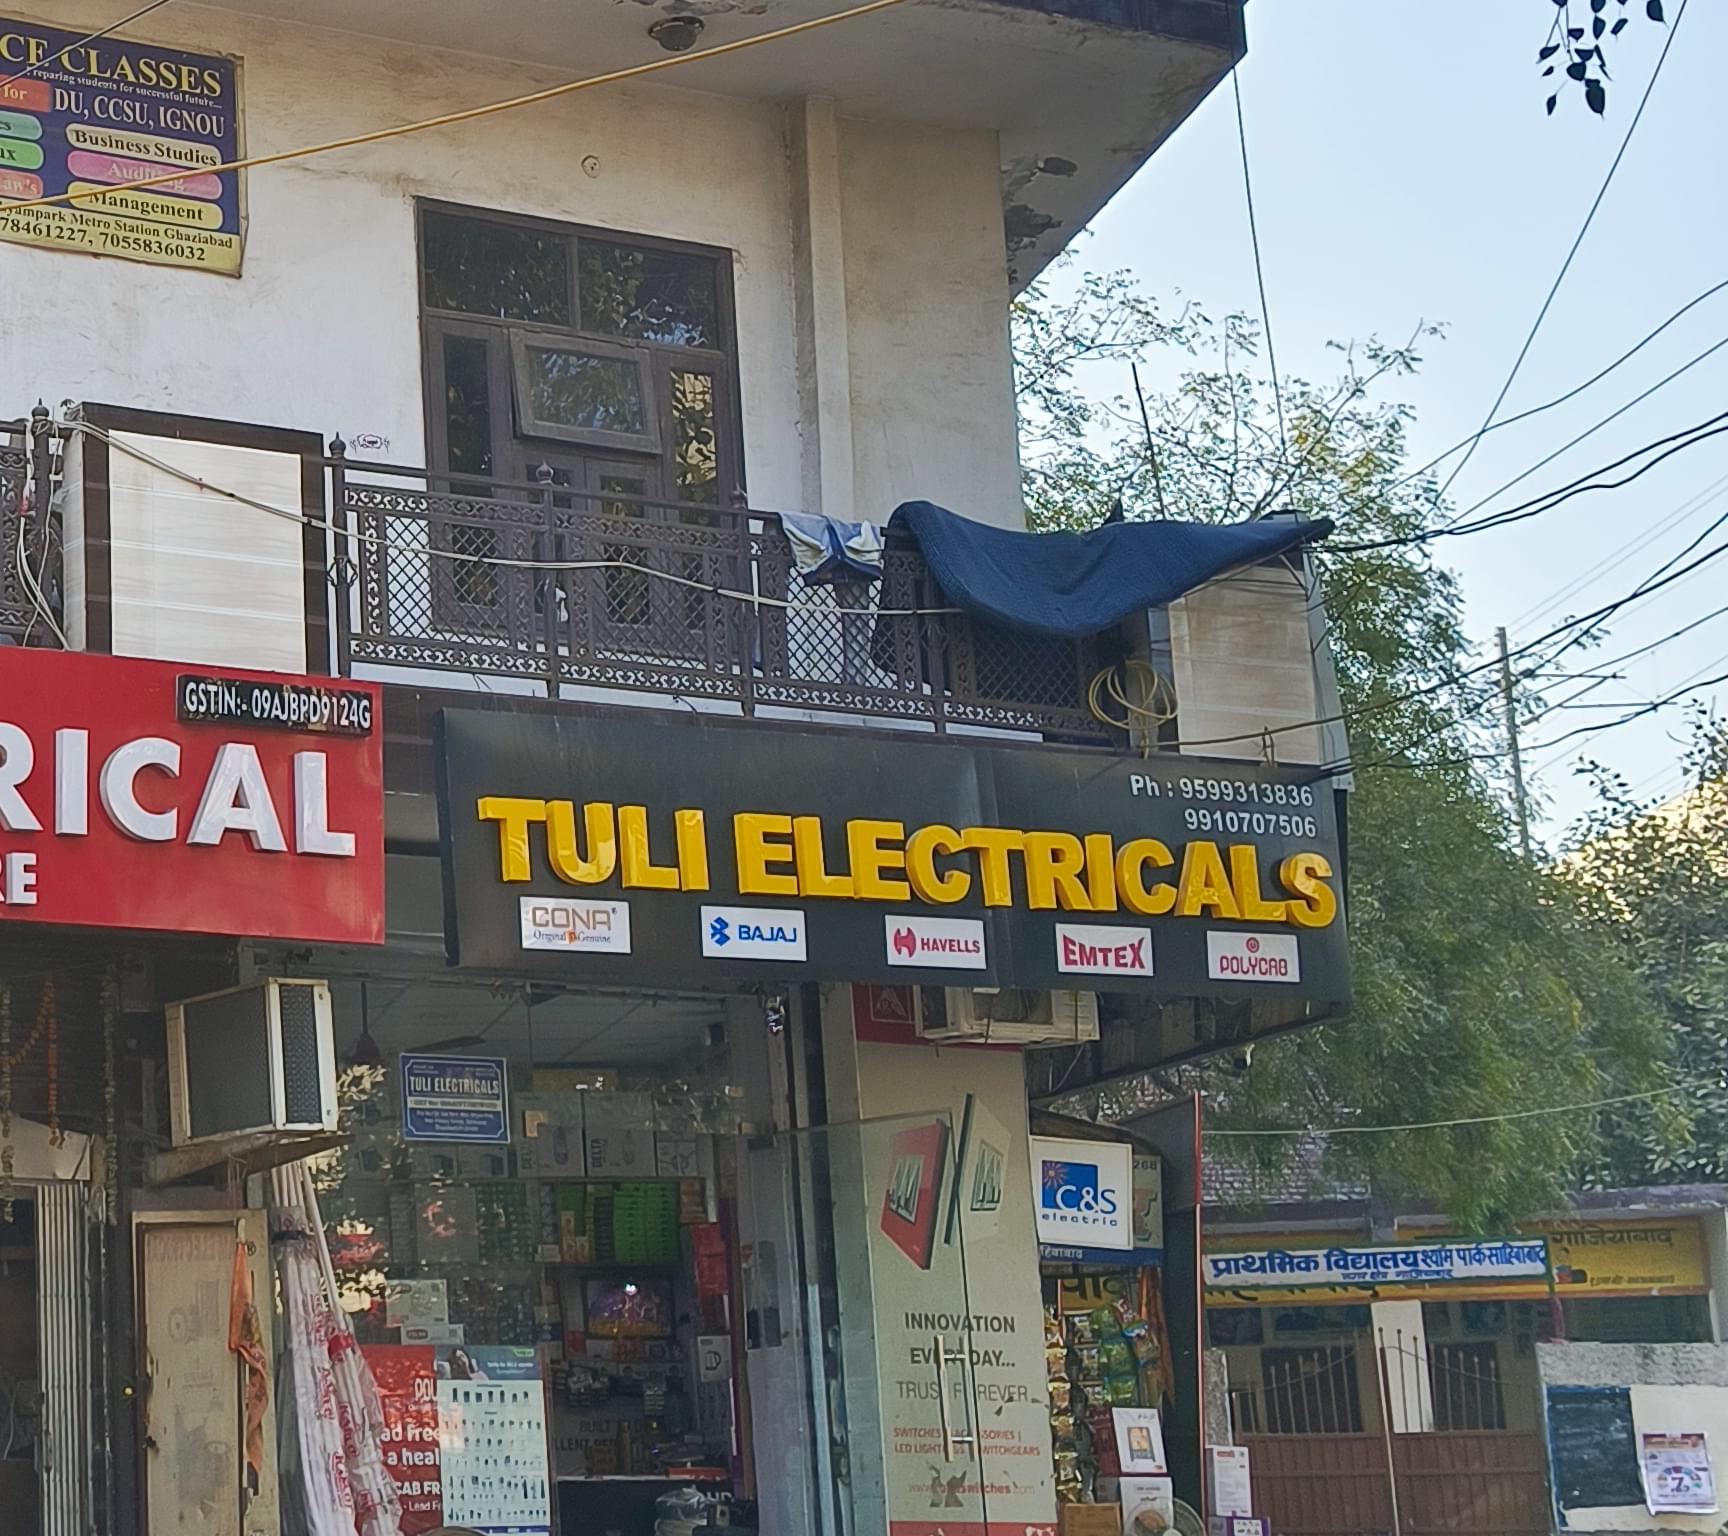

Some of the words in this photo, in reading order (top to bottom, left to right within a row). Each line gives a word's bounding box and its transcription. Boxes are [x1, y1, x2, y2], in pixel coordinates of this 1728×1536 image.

[25, 65, 75, 84] reparing
[60, 46, 222, 97] CLASSES
[2, 83, 28, 101] for
[54, 88, 89, 120] DU,
[94, 94, 154, 129] CCSU,
[160, 106, 225, 138] IGNOU
[74, 129, 151, 156] Business
[154, 141, 218, 167] Studies
[88, 192, 205, 221] Management
[69, 214, 111, 232] Metro
[114, 219, 160, 238] Station
[164, 228, 233, 250] Ghaziabad
[102, 232, 206, 261] 7055836032
[1130, 774, 1161, 798] Ph
[1179, 776, 1314, 808] 9599313836
[1184, 808, 1317, 839] 9910707506
[477, 796, 711, 893] TULI
[733, 811, 1338, 929] ELECTRICALS
[531, 905, 612, 932] CONA
[738, 924, 798, 943] BAJAJ
[921, 936, 981, 955] HAVELLS
[1062, 933, 1145, 970] EMTEX
[1219, 954, 1289, 977] POLYCAB
[1055, 1184, 1117, 1215] C&S
[1041, 1212, 1119, 1228] electric
[1209, 1248, 1320, 1279] प्राथमिक
[1323, 1246, 1421, 1275] विद्यालय
[904, 1311, 1016, 1333] INNOVATION
[896, 1380, 940, 1401] TRUS
[953, 1383, 1028, 1402] FREVER
